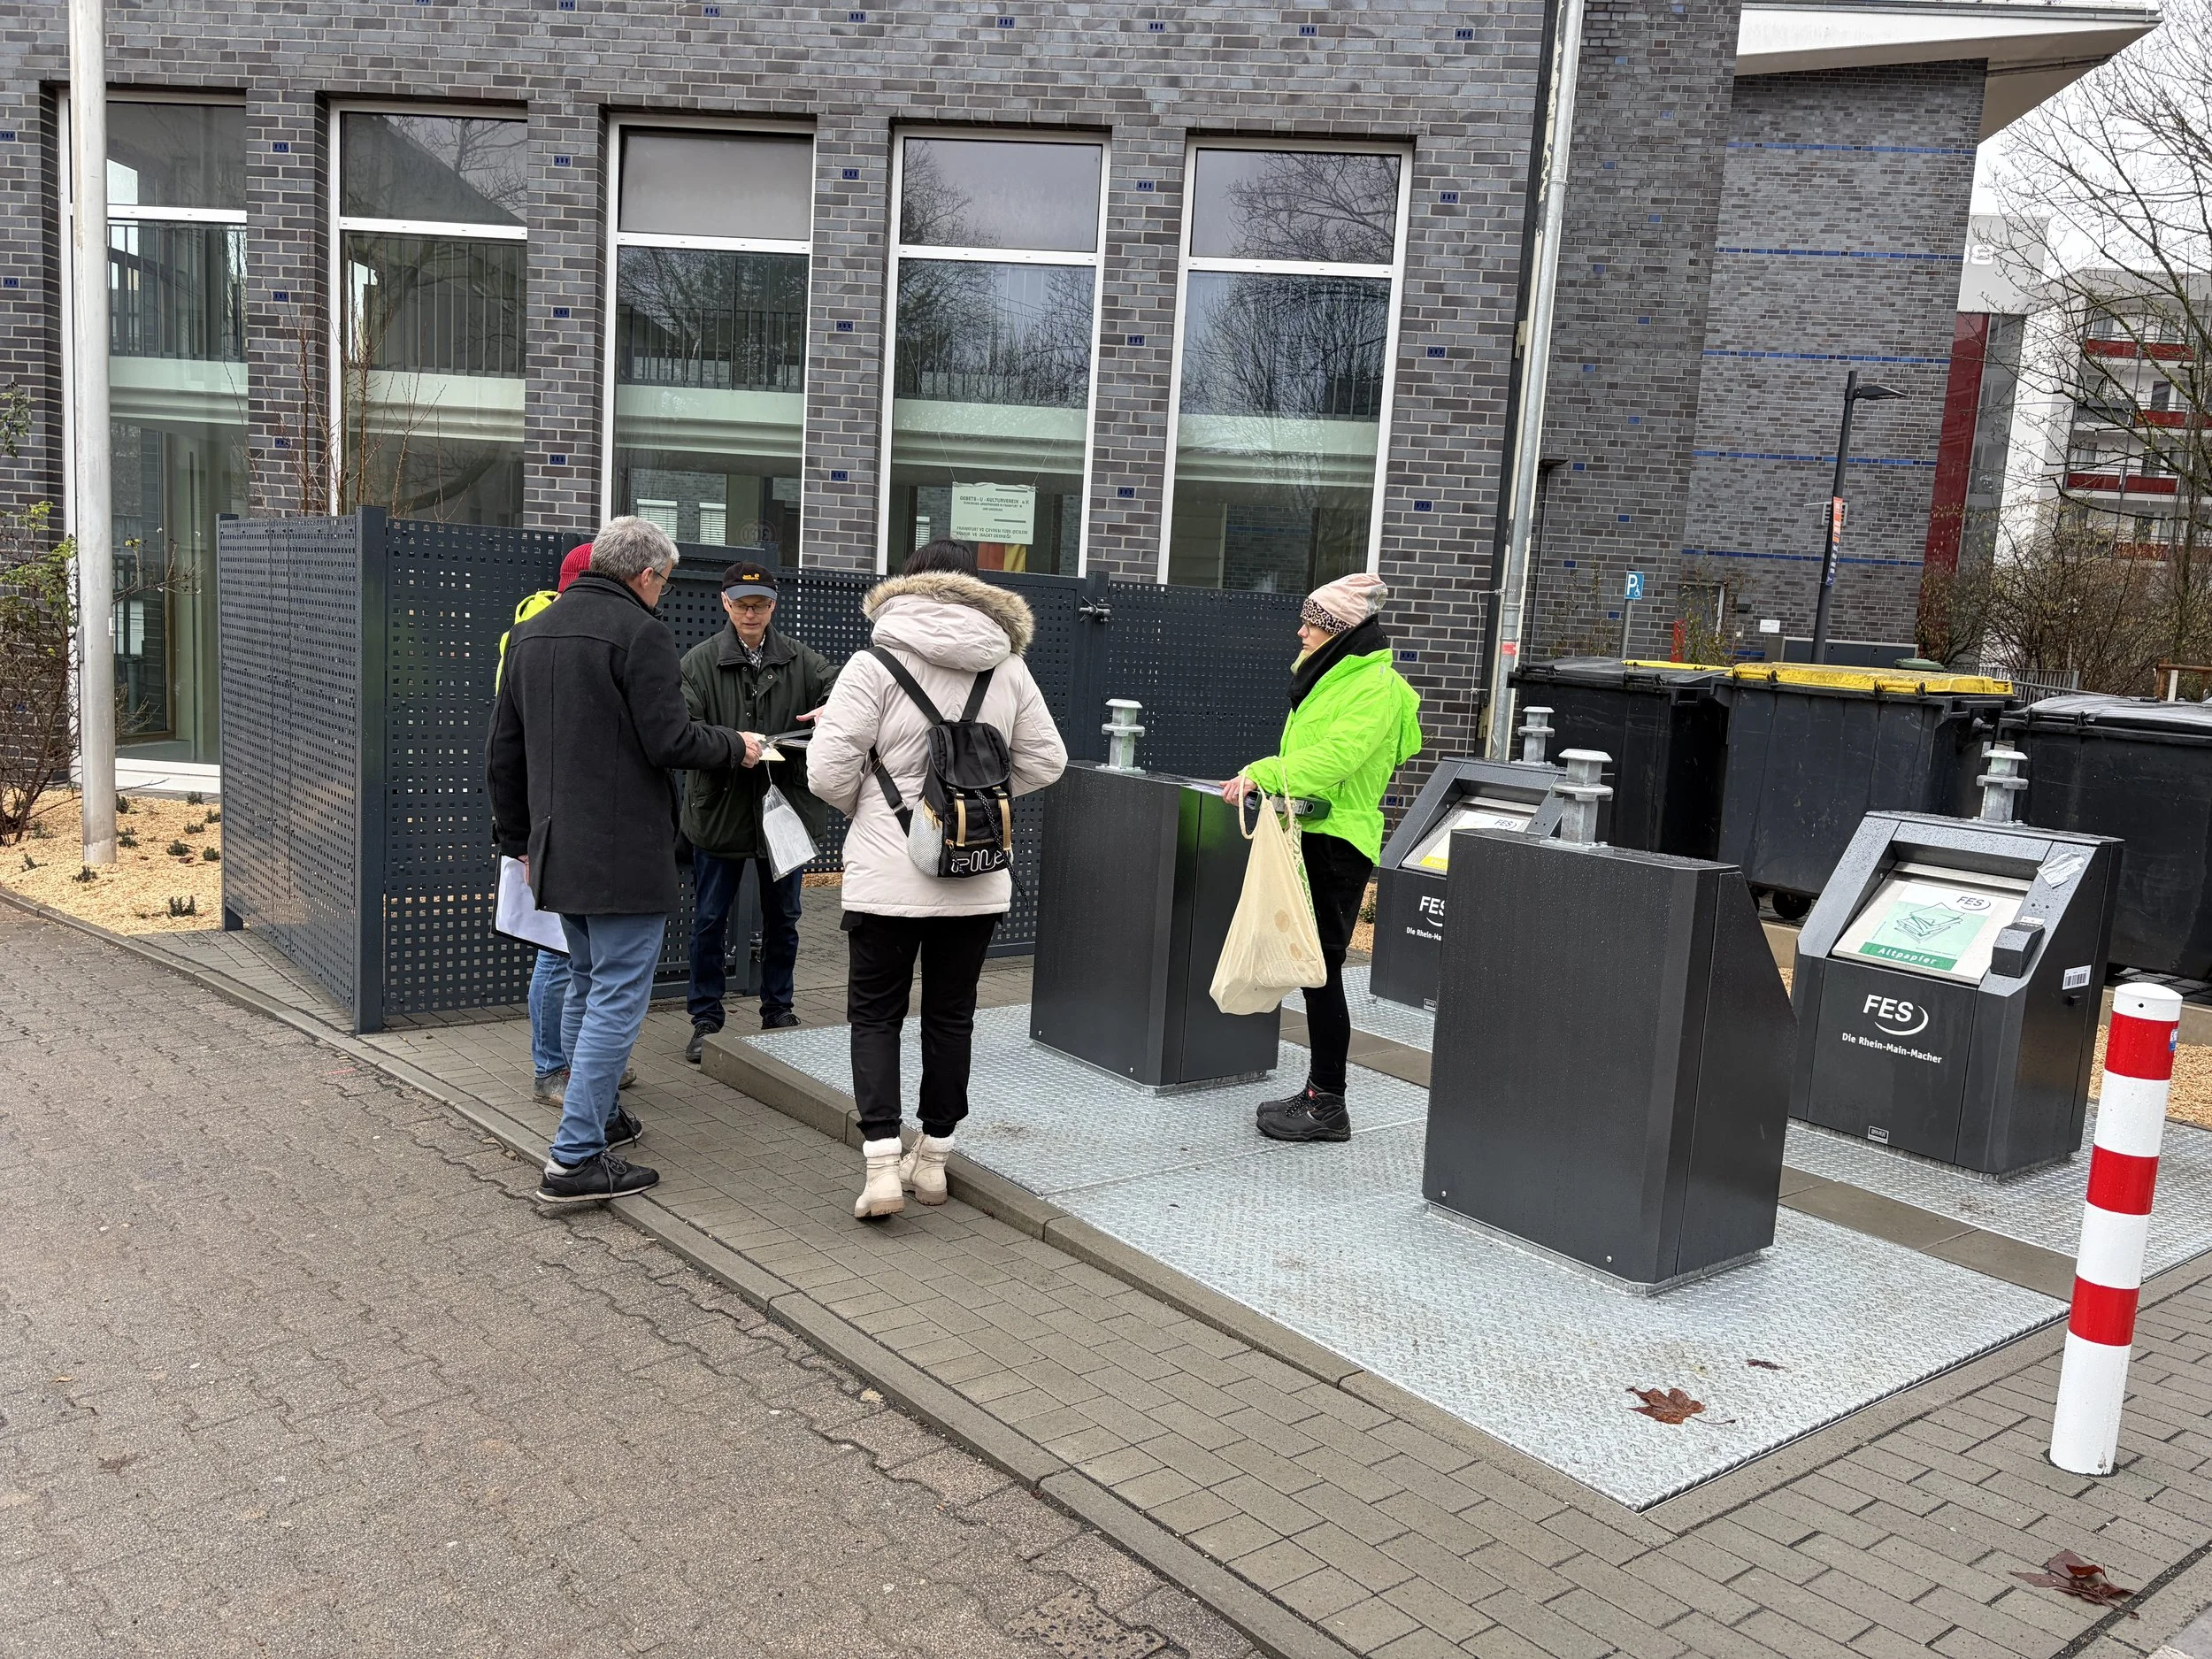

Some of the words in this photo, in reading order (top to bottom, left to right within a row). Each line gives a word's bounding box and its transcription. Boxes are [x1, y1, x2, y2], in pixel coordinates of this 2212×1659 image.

[1626, 573, 1638, 595] P
[1494, 819, 1514, 828] FES
[1956, 895, 1985, 907] FES
[1407, 926, 1416, 935] Die
[1417, 929, 1442, 941] Rhein-Ma
[1878, 947, 1939, 965] Altpapier
[1863, 994, 1914, 1023] FES
[1841, 1032, 1856, 1043] Die
[1858, 1036, 1942, 1064] Rhein-Main-Macher
